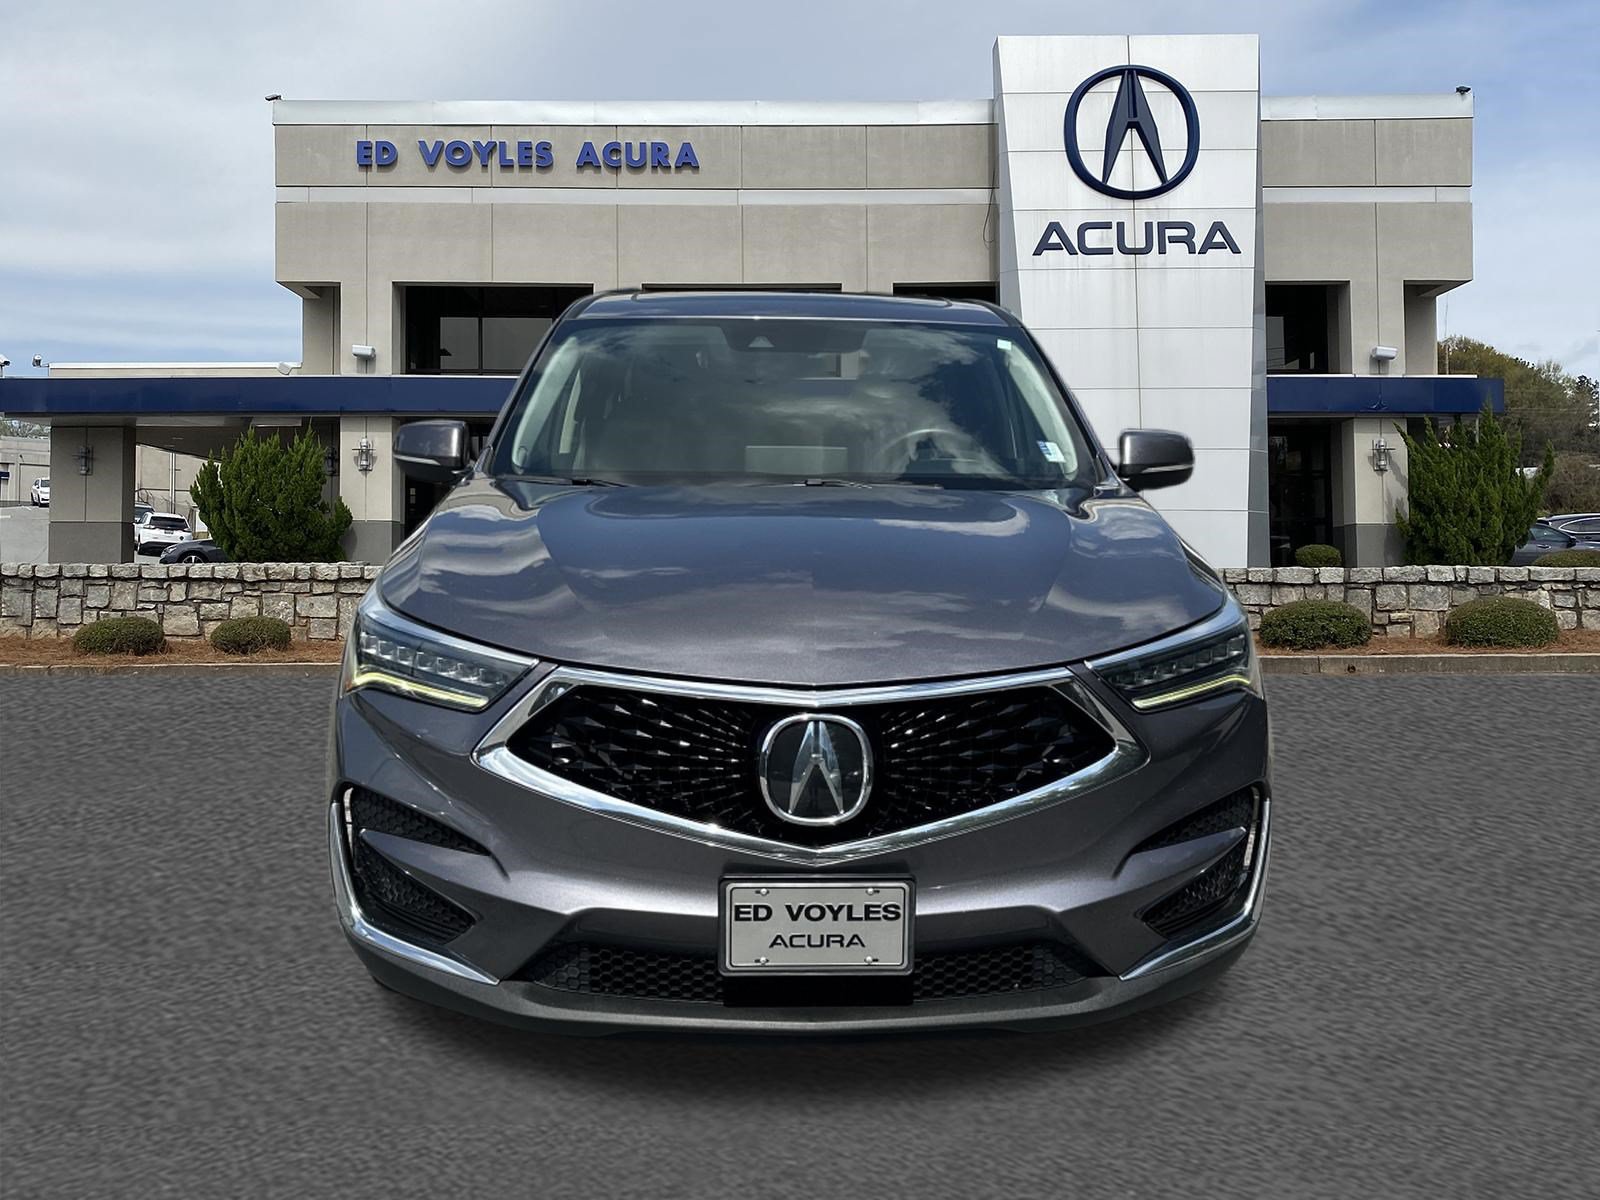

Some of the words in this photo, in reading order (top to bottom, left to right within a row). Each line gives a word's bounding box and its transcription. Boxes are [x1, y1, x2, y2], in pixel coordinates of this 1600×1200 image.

[356, 140, 398, 168] ED
[418, 140, 554, 168] VOYLES
[576, 141, 700, 169] ACURA
[1032, 221, 1241, 255] ACURA
[734, 904, 772, 921] ED
[785, 904, 901, 921] VOYLES
[769, 934, 866, 948] ACURA
